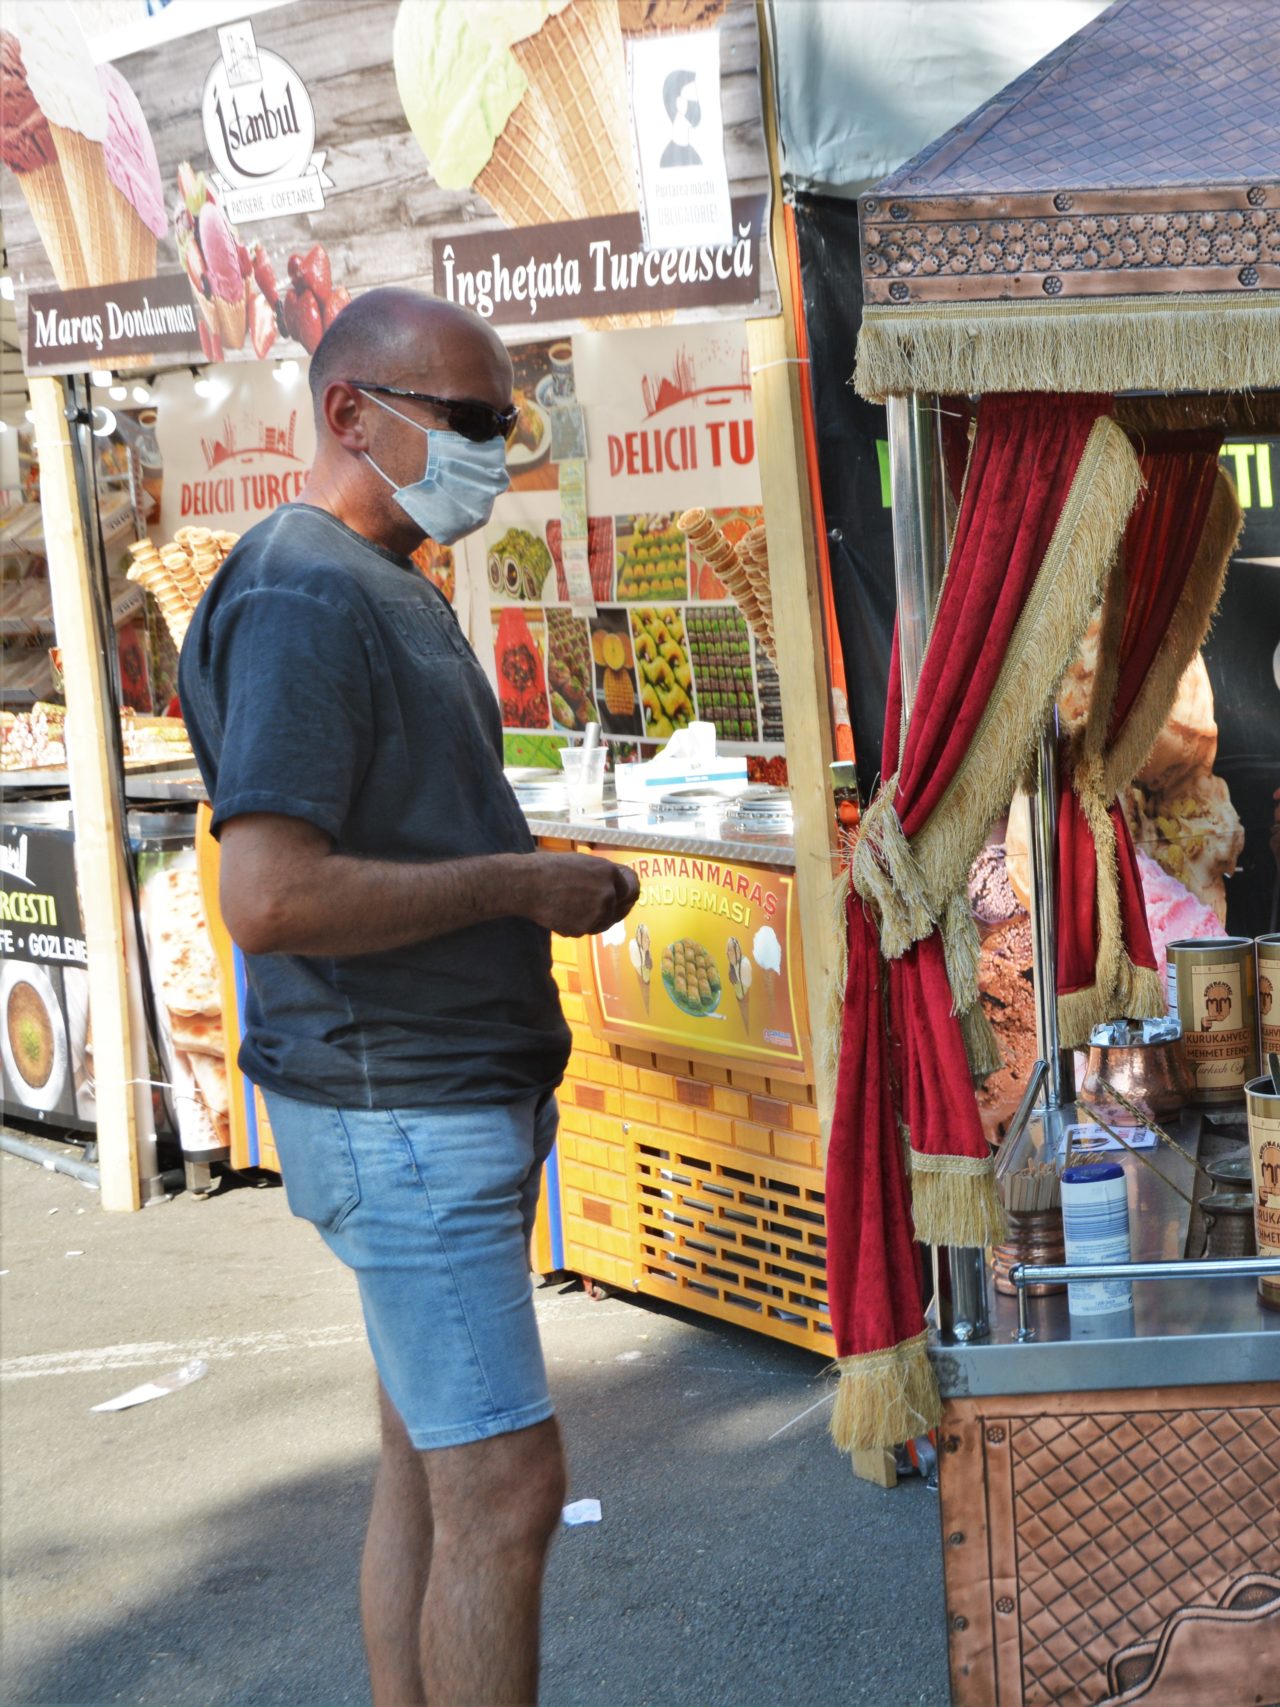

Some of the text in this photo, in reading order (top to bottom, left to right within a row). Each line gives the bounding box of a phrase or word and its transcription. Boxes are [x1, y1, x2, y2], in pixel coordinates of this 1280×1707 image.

[607, 425, 698, 478] DELICII
[180, 477, 235, 517] DELICII
[639, 883, 751, 928] ONDURMASI
[1187, 1048, 1224, 1058] MEHMET
